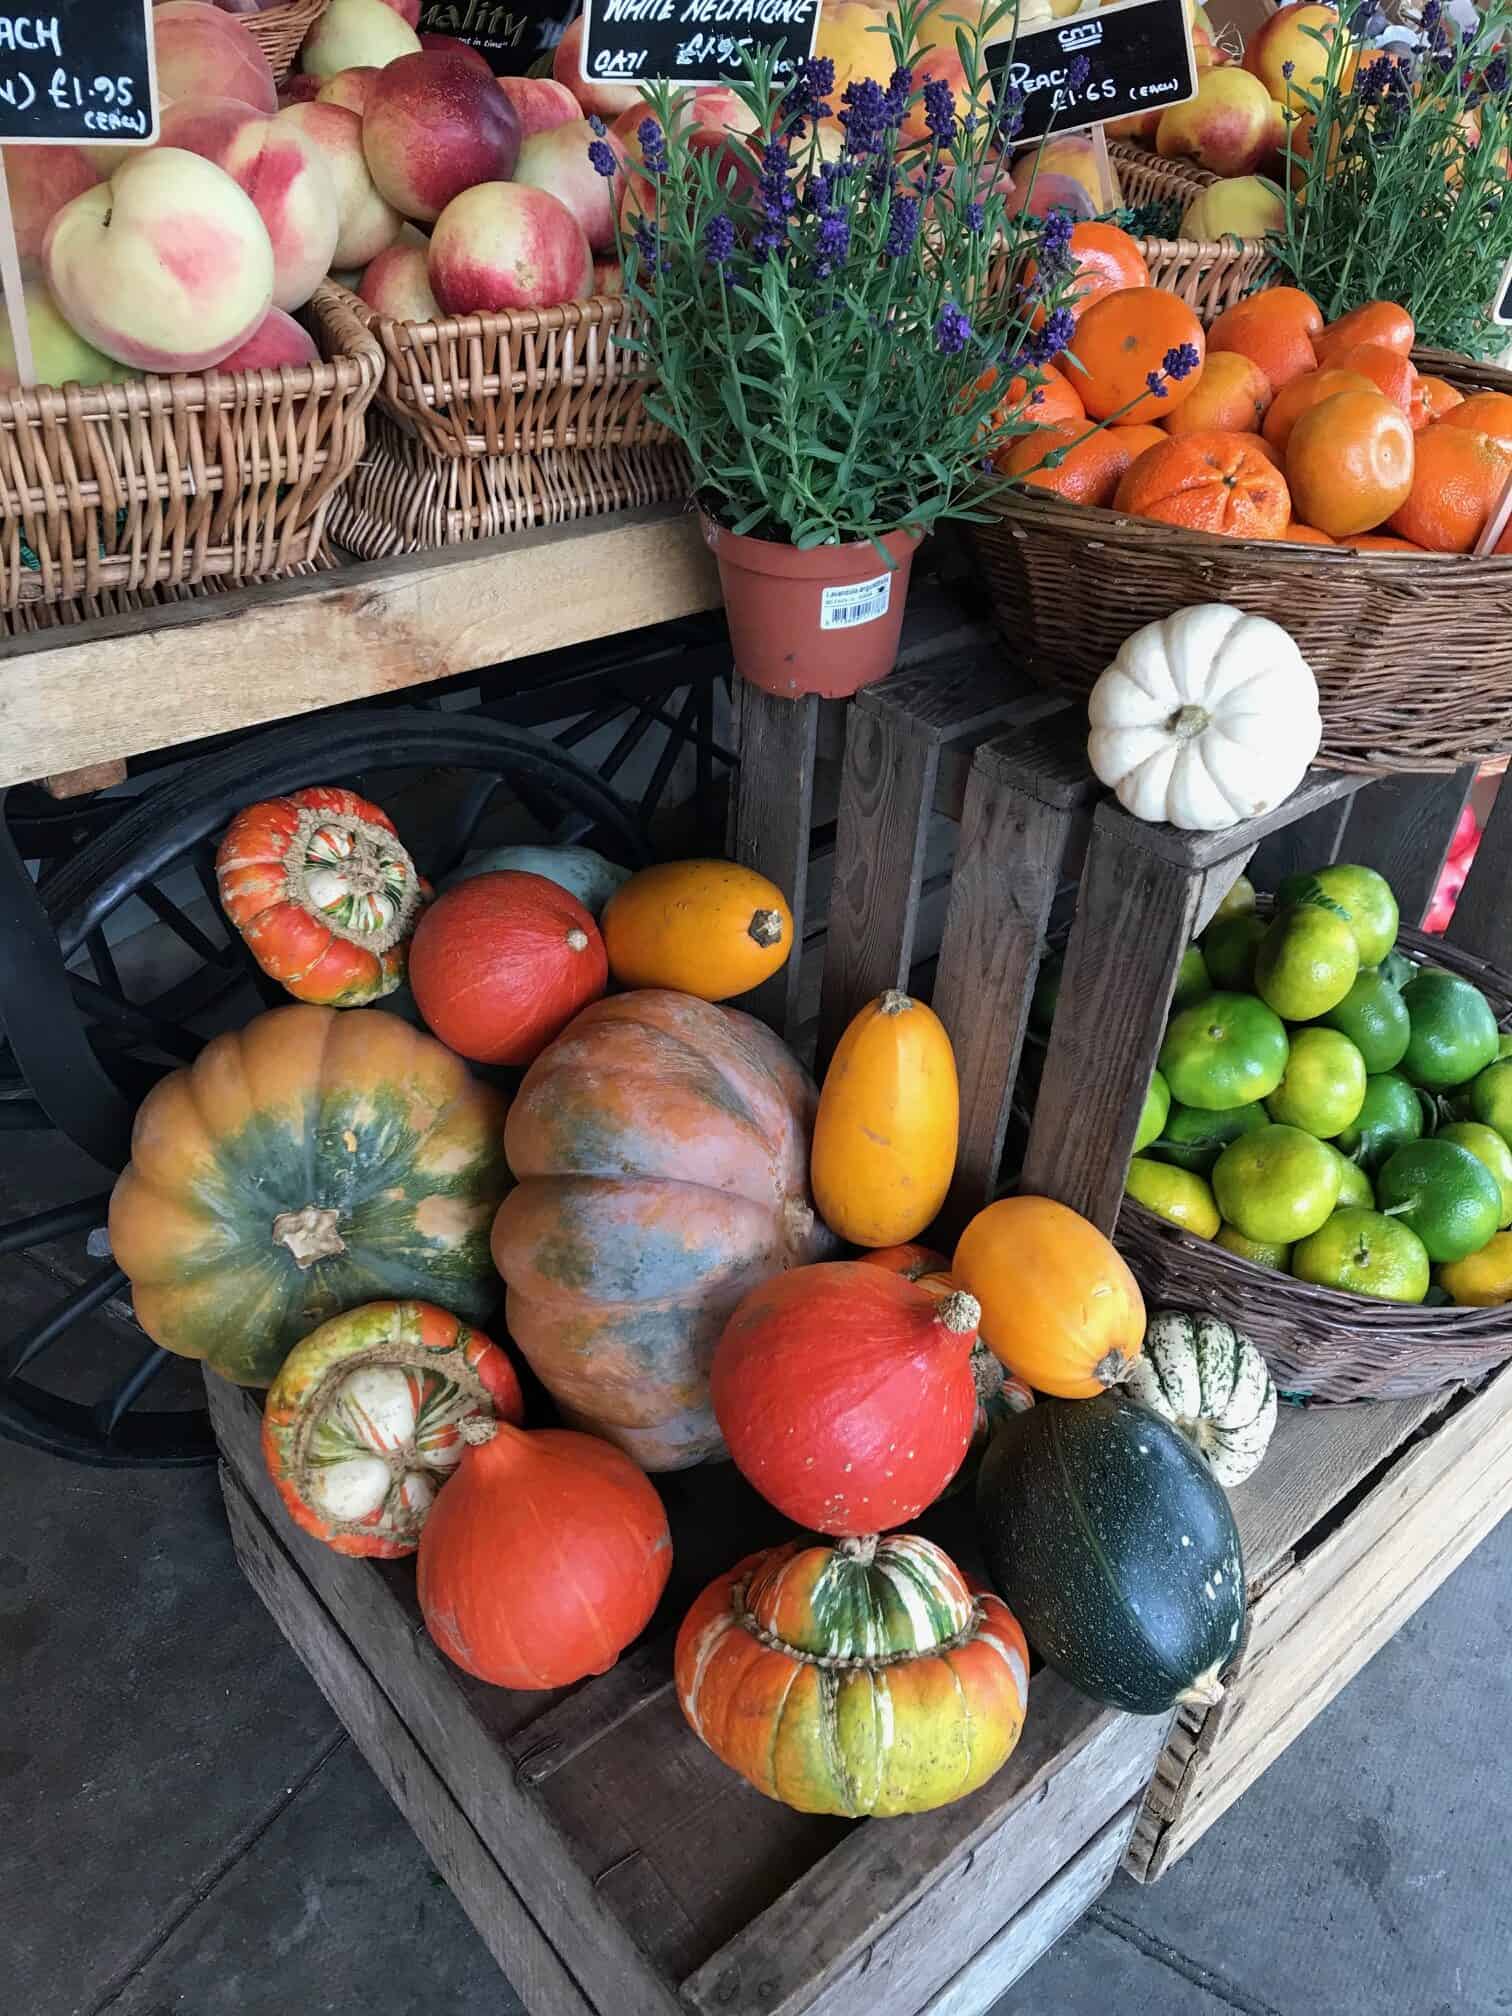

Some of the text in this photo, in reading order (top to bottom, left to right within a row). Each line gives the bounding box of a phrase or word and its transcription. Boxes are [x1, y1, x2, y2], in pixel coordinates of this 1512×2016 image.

[603, 0, 675, 22] WHITE
[48, 68, 133, 108] £1.95
[1007, 63, 1069, 93] PEAC
[1051, 79, 1116, 111] £1.65
